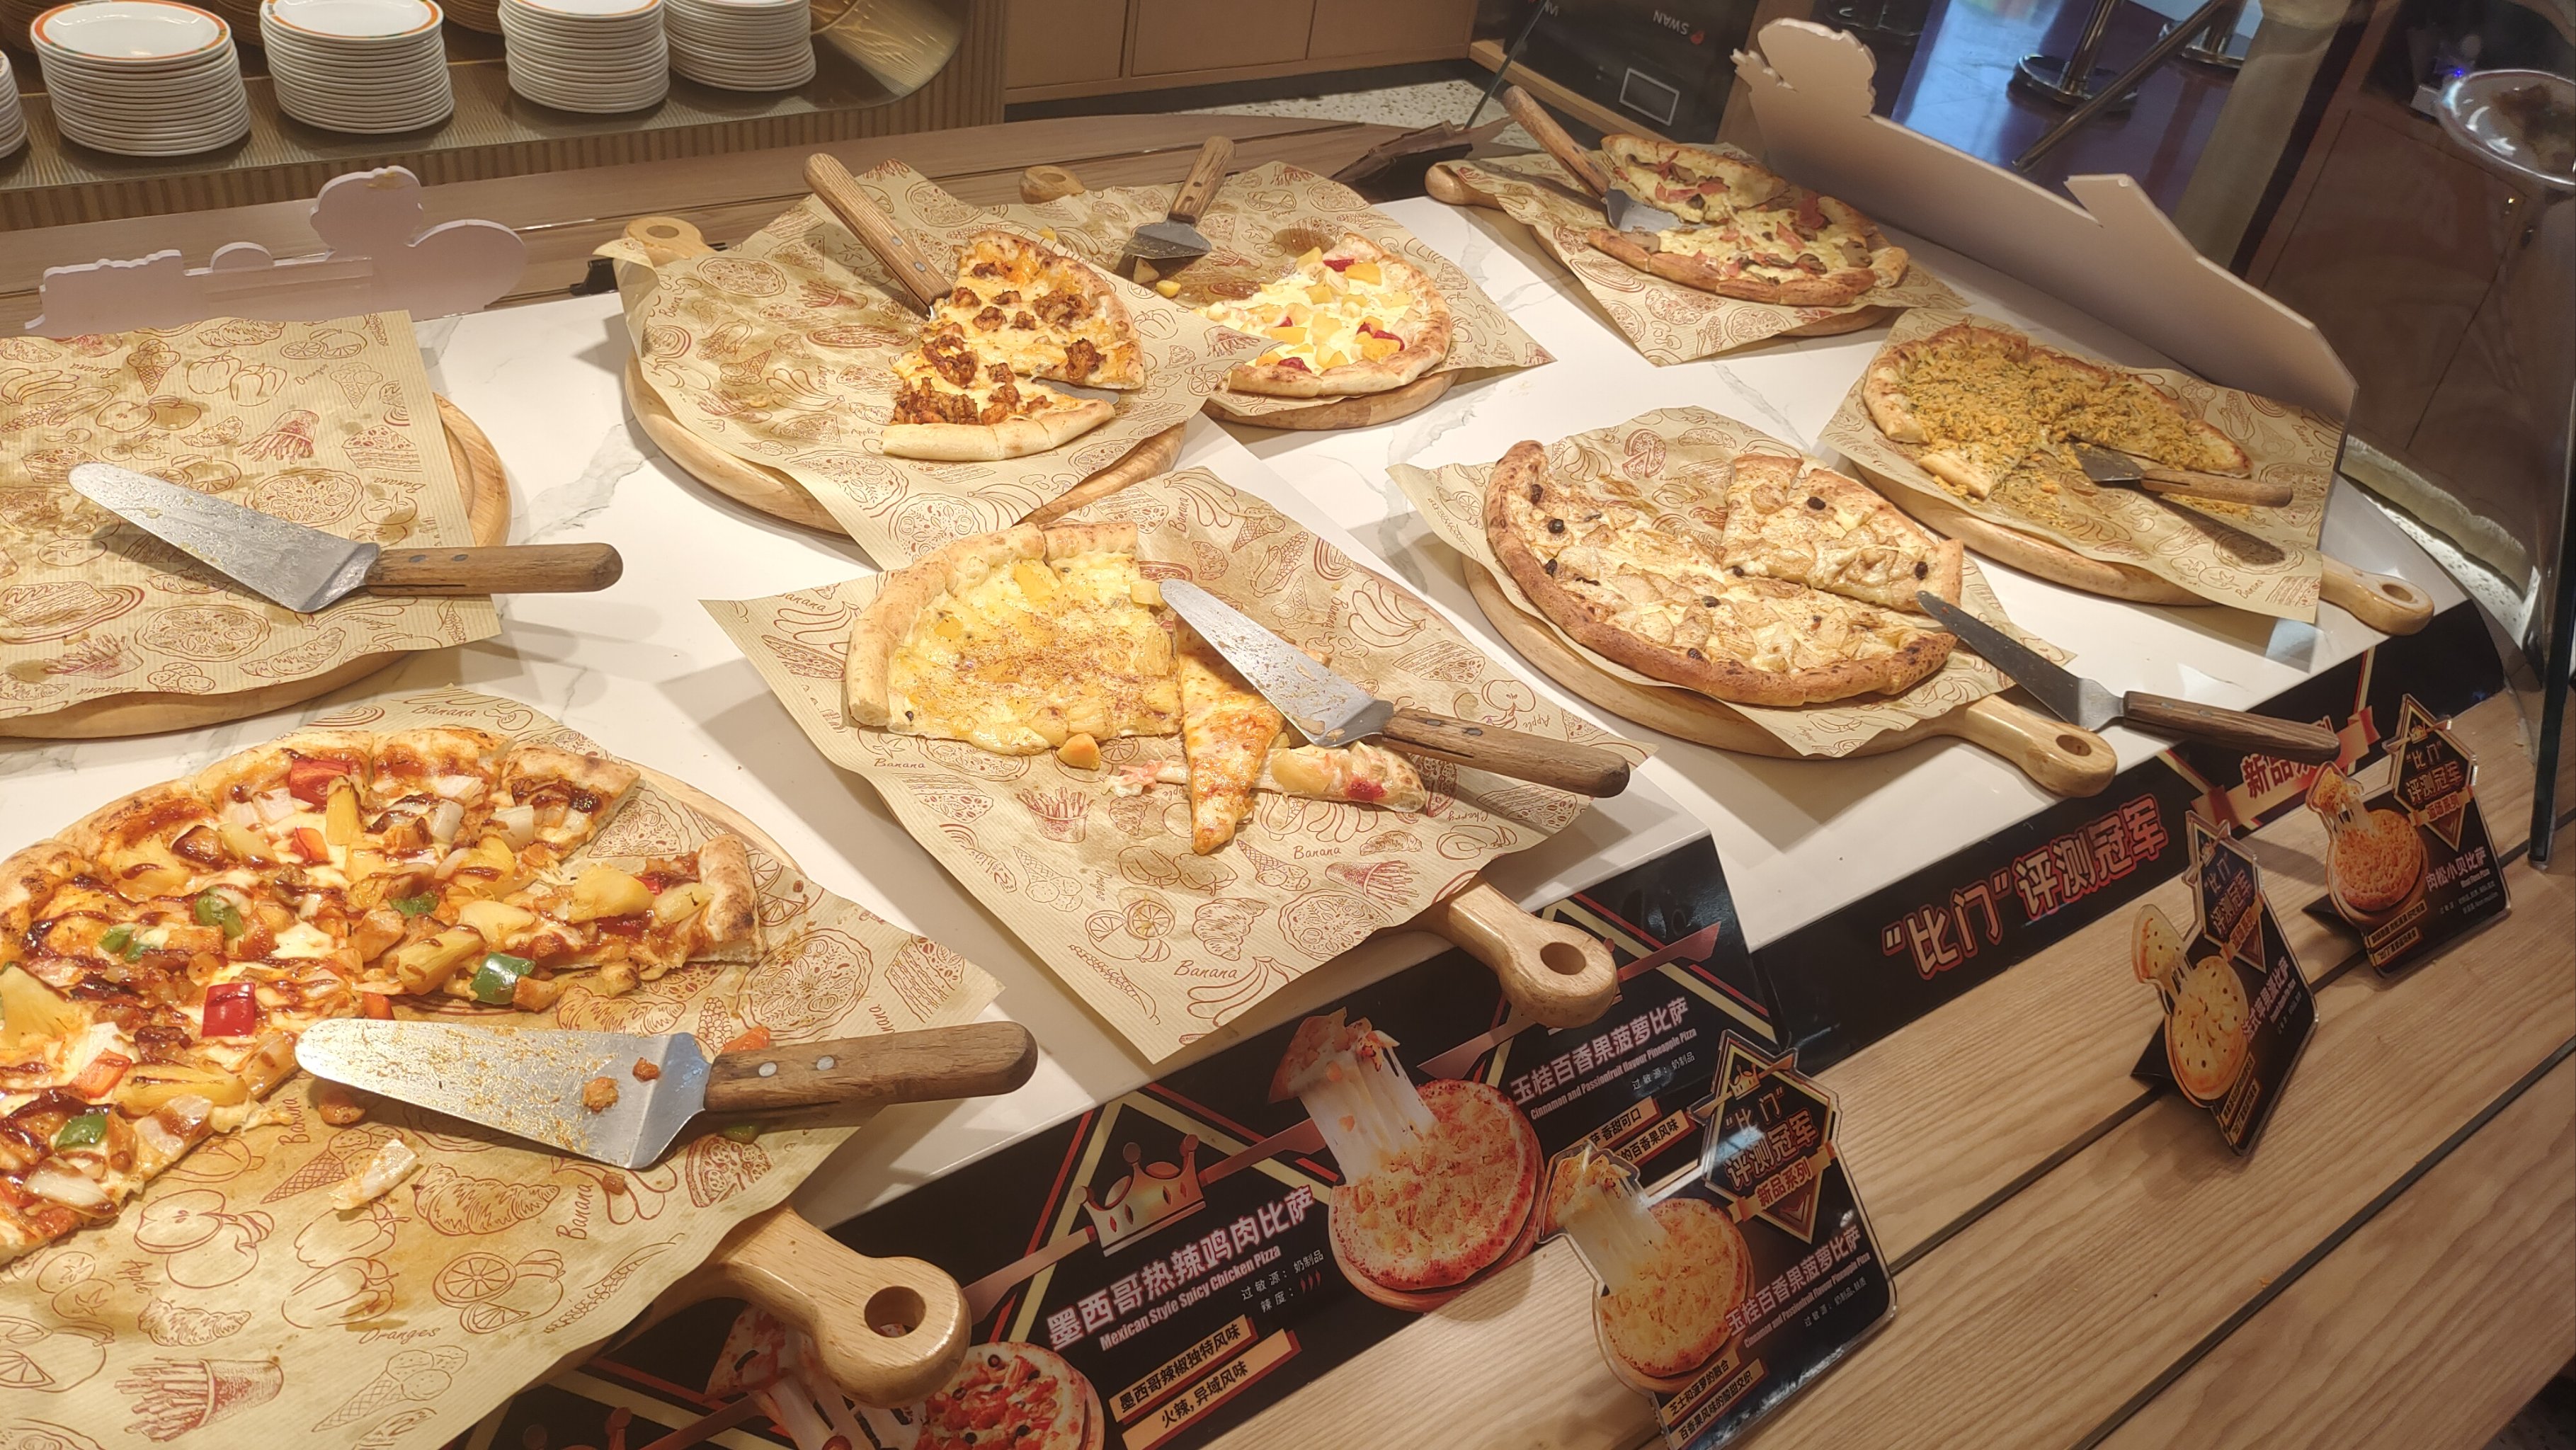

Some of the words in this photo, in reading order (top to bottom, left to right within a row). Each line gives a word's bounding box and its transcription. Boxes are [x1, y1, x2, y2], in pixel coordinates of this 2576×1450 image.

[1653, 10, 1689, 35] SWAN
[374, 477, 426, 493] Banana
[1168, 498, 1189, 532] Banana
[775, 593, 826, 612] anana
[1523, 714, 1551, 732] Apple
[874, 758, 925, 769] Banana
[1447, 810, 1488, 822] Cherry
[1293, 845, 1341, 860] Banana
[2425, 846, 2487, 892] 肉松小贝比萨
[1885, 799, 2165, 973] “比门”评测冠军
[1174, 960, 1237, 978] Banana
[1510, 995, 1689, 1104] 玉桂百香果菠萝比萨
[1671, 1051, 1695, 1071] 奶制品
[1530, 1095, 1568, 1120] Cinnamon
[1568, 1086, 1582, 1101] and
[1581, 1065, 1624, 1094] Passionfruit
[1646, 1036, 1681, 1061] Pineapple
[1680, 1028, 1698, 1044] Pizza
[1601, 1107, 1642, 1141] 香甜可口
[1724, 1109, 1818, 1189] 评测冠军
[1756, 1156, 1812, 1209] 新品系列
[556, 1184, 593, 1240] Banana
[115, 1260, 161, 1294] Apple
[1047, 1184, 1316, 1351] 墨西哥热辣鸡肉比萨
[1293, 1248, 1324, 1274] 奶制品
[1724, 1224, 1862, 1337] 玉桂百香果菠萝比萨
[1099, 1317, 1150, 1352] Mexican
[1150, 1298, 1179, 1325] Style
[1178, 1280, 1211, 1308] Spicy
[1210, 1260, 1255, 1292] Chicken
[1253, 1245, 1282, 1270] Pizza
[1743, 1323, 1772, 1348] Cinnamon
[1772, 1313, 1784, 1329] and
[1782, 1292, 1815, 1321] Passionfruit
[1831, 1261, 1858, 1285] Pineapple
[1856, 1252, 1871, 1267] Pizza
[359, 1328, 441, 1345] Oranges
[1119, 1322, 1242, 1413] 墨西哥辣椒独特风味
[1669, 1359, 1729, 1416] 芝士和菠萝的融合
[1679, 1370, 1753, 1440] 百香果风味的酸甜交织
